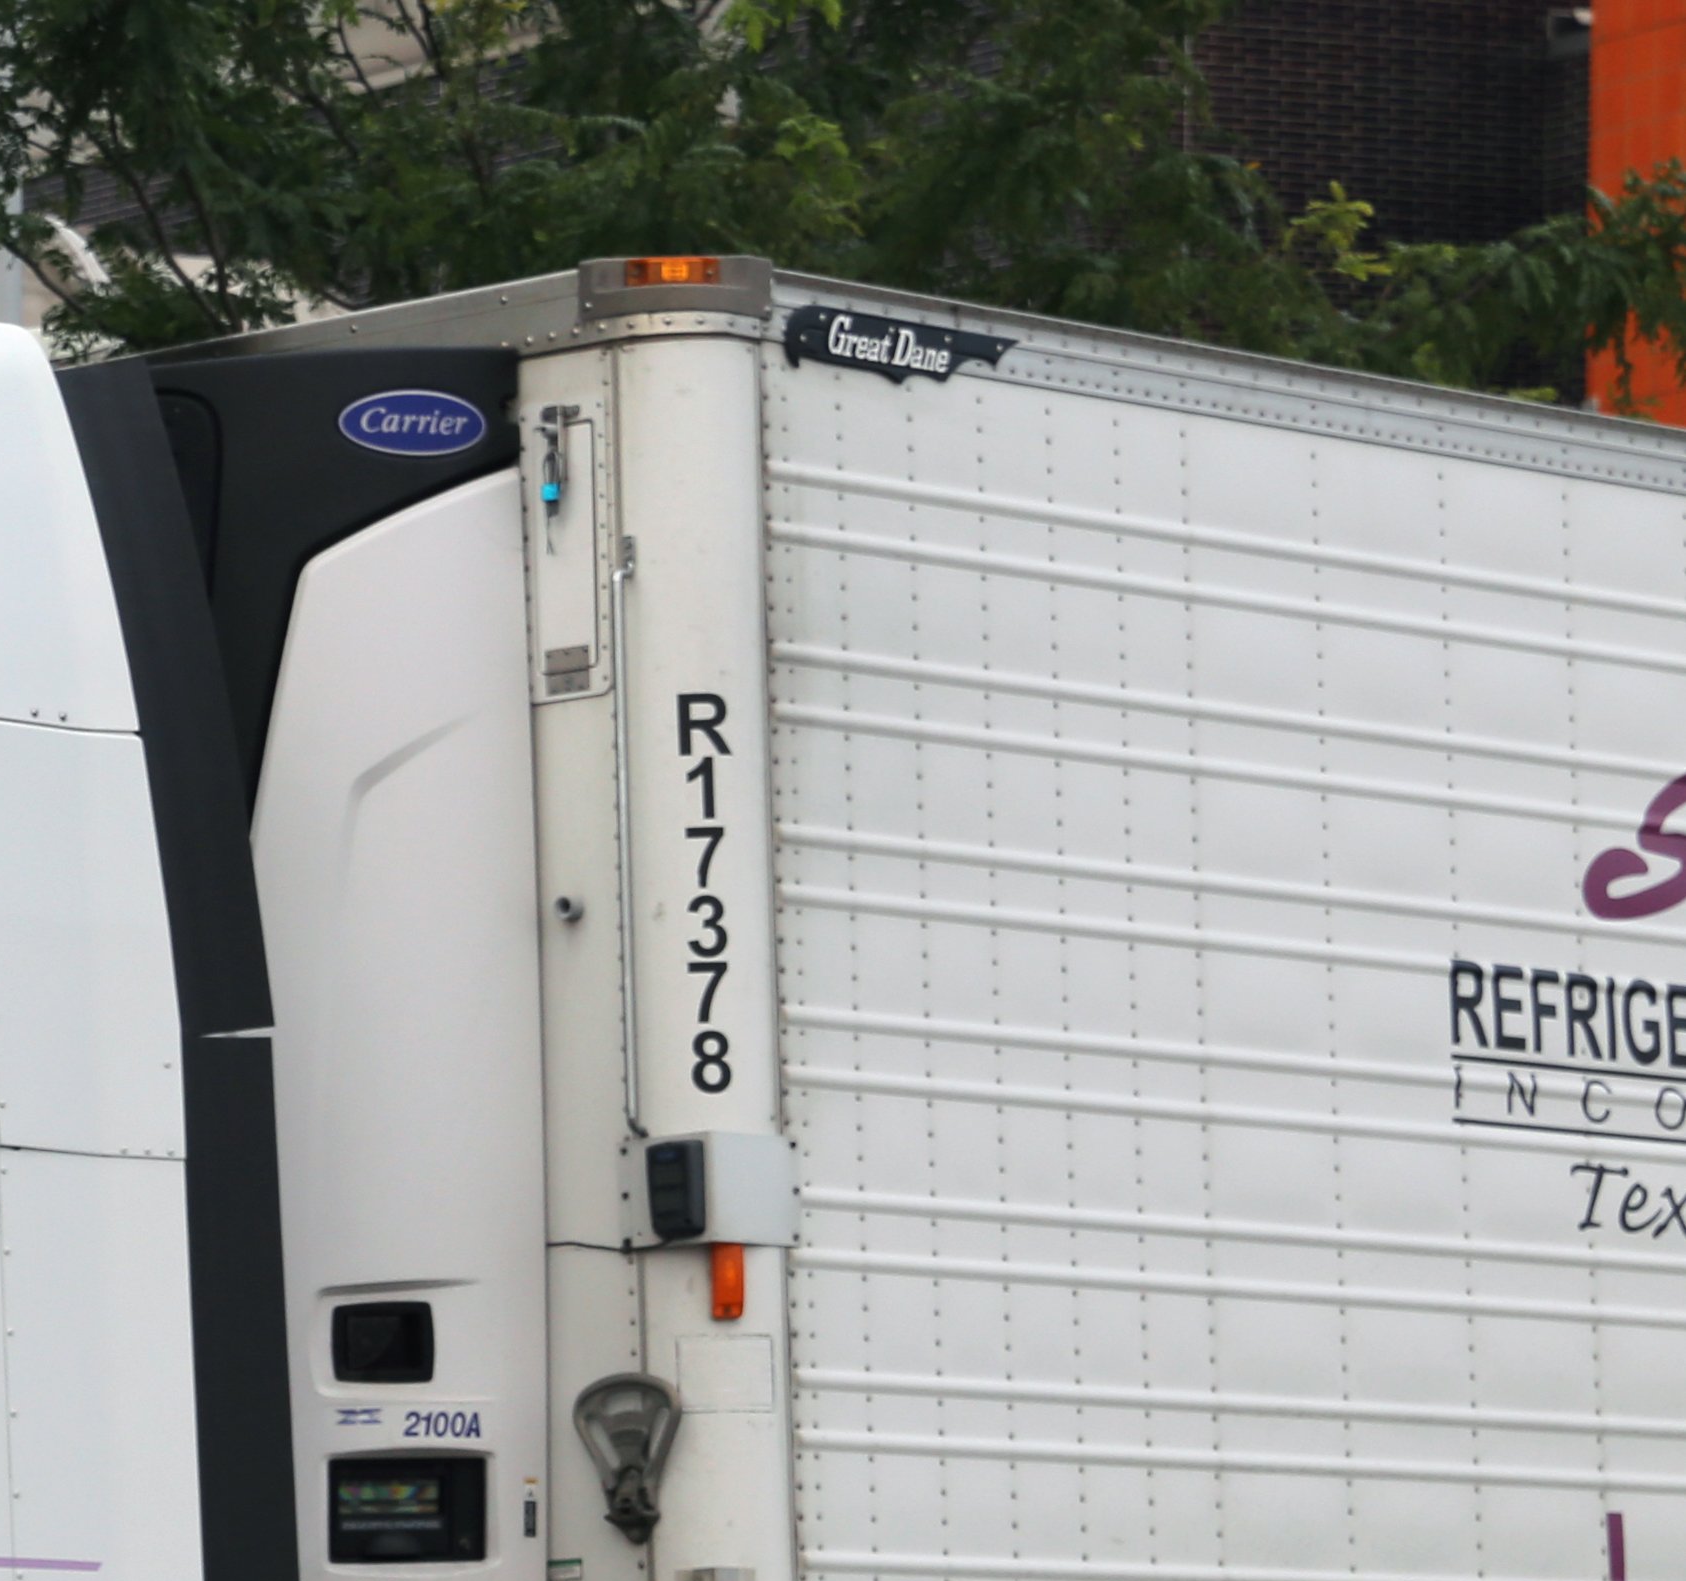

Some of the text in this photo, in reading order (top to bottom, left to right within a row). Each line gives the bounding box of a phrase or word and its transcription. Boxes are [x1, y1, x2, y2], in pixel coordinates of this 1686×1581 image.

[828, 313, 953, 373] Great Dane
[360, 407, 468, 435] Carrier
[676, 692, 732, 1094] R17378
[403, 1411, 481, 1438] 2100A
